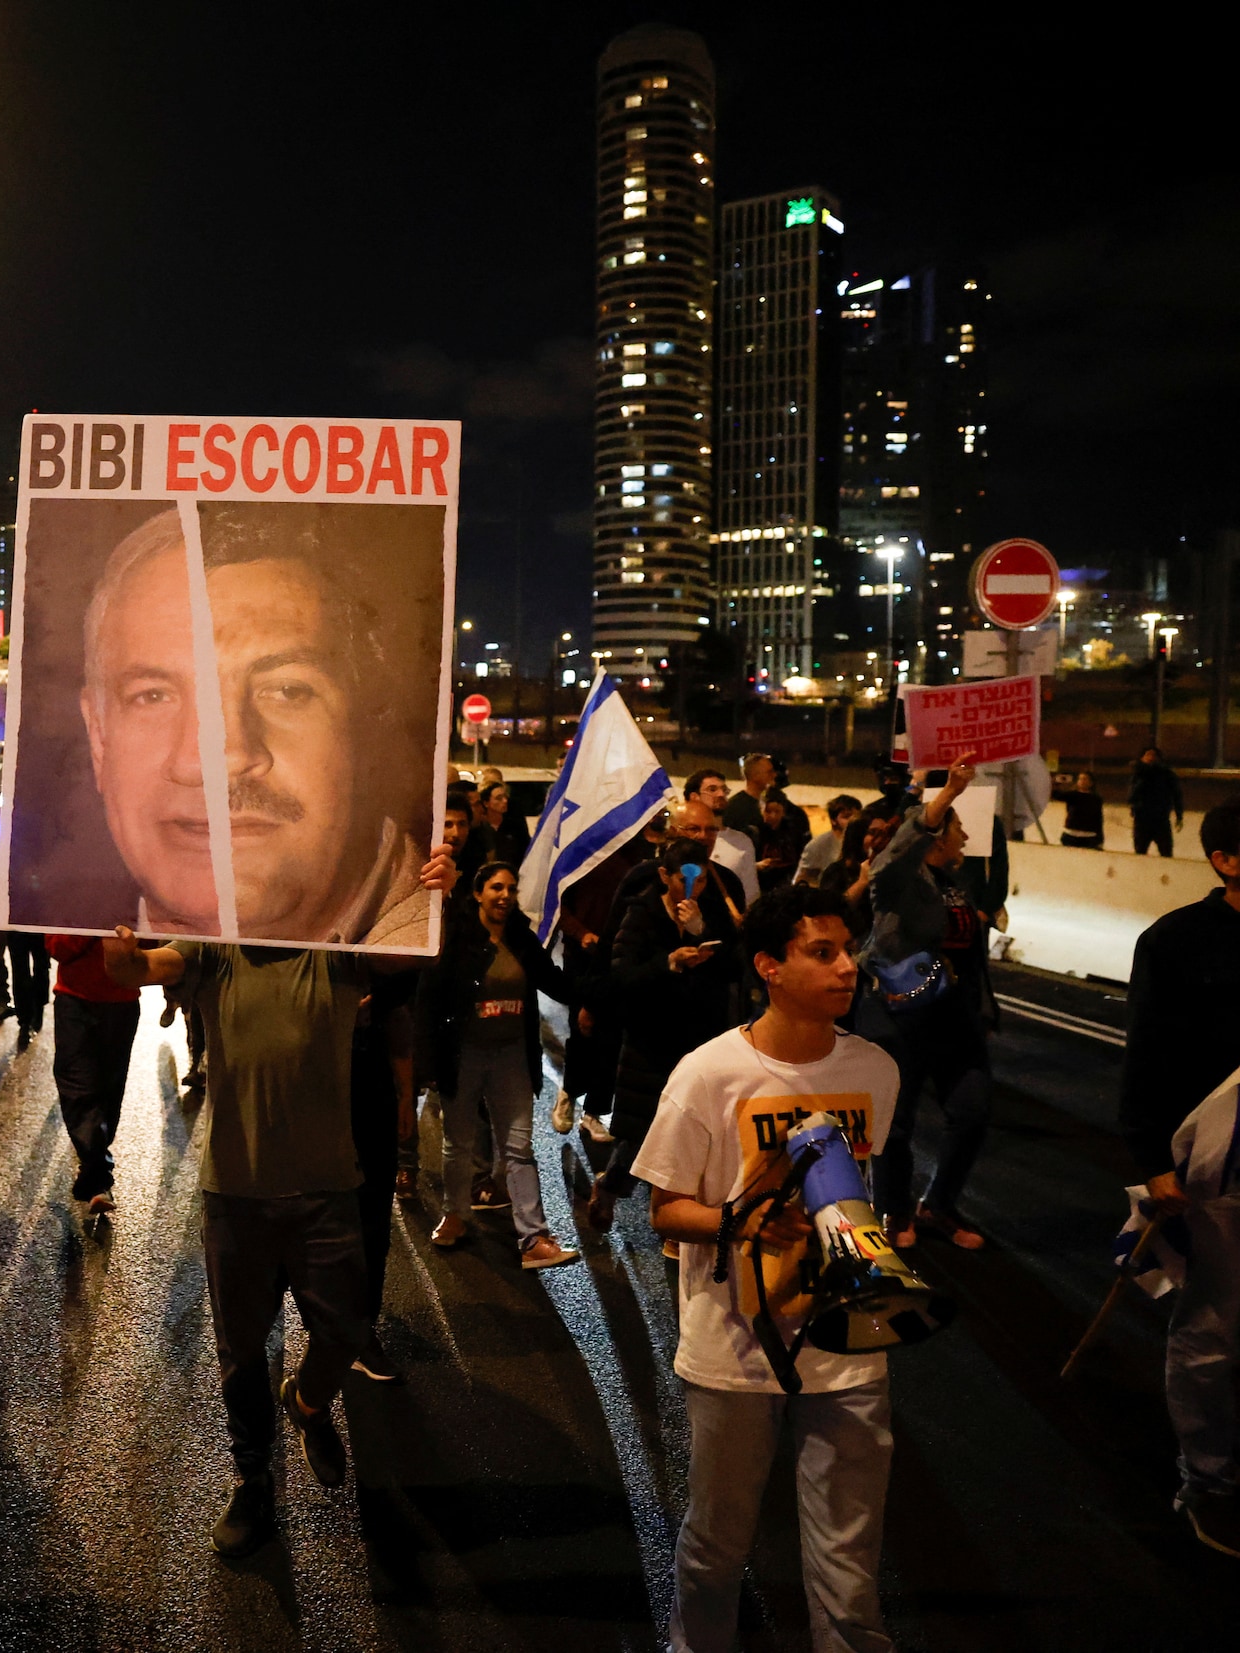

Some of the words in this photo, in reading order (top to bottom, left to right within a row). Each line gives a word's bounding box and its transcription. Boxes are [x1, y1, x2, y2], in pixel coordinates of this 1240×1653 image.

[29, 423, 145, 491] BIBI
[166, 423, 450, 496] ESCOBAR
[923, 691, 956, 709] את
[964, 680, 1032, 705] תעצרו
